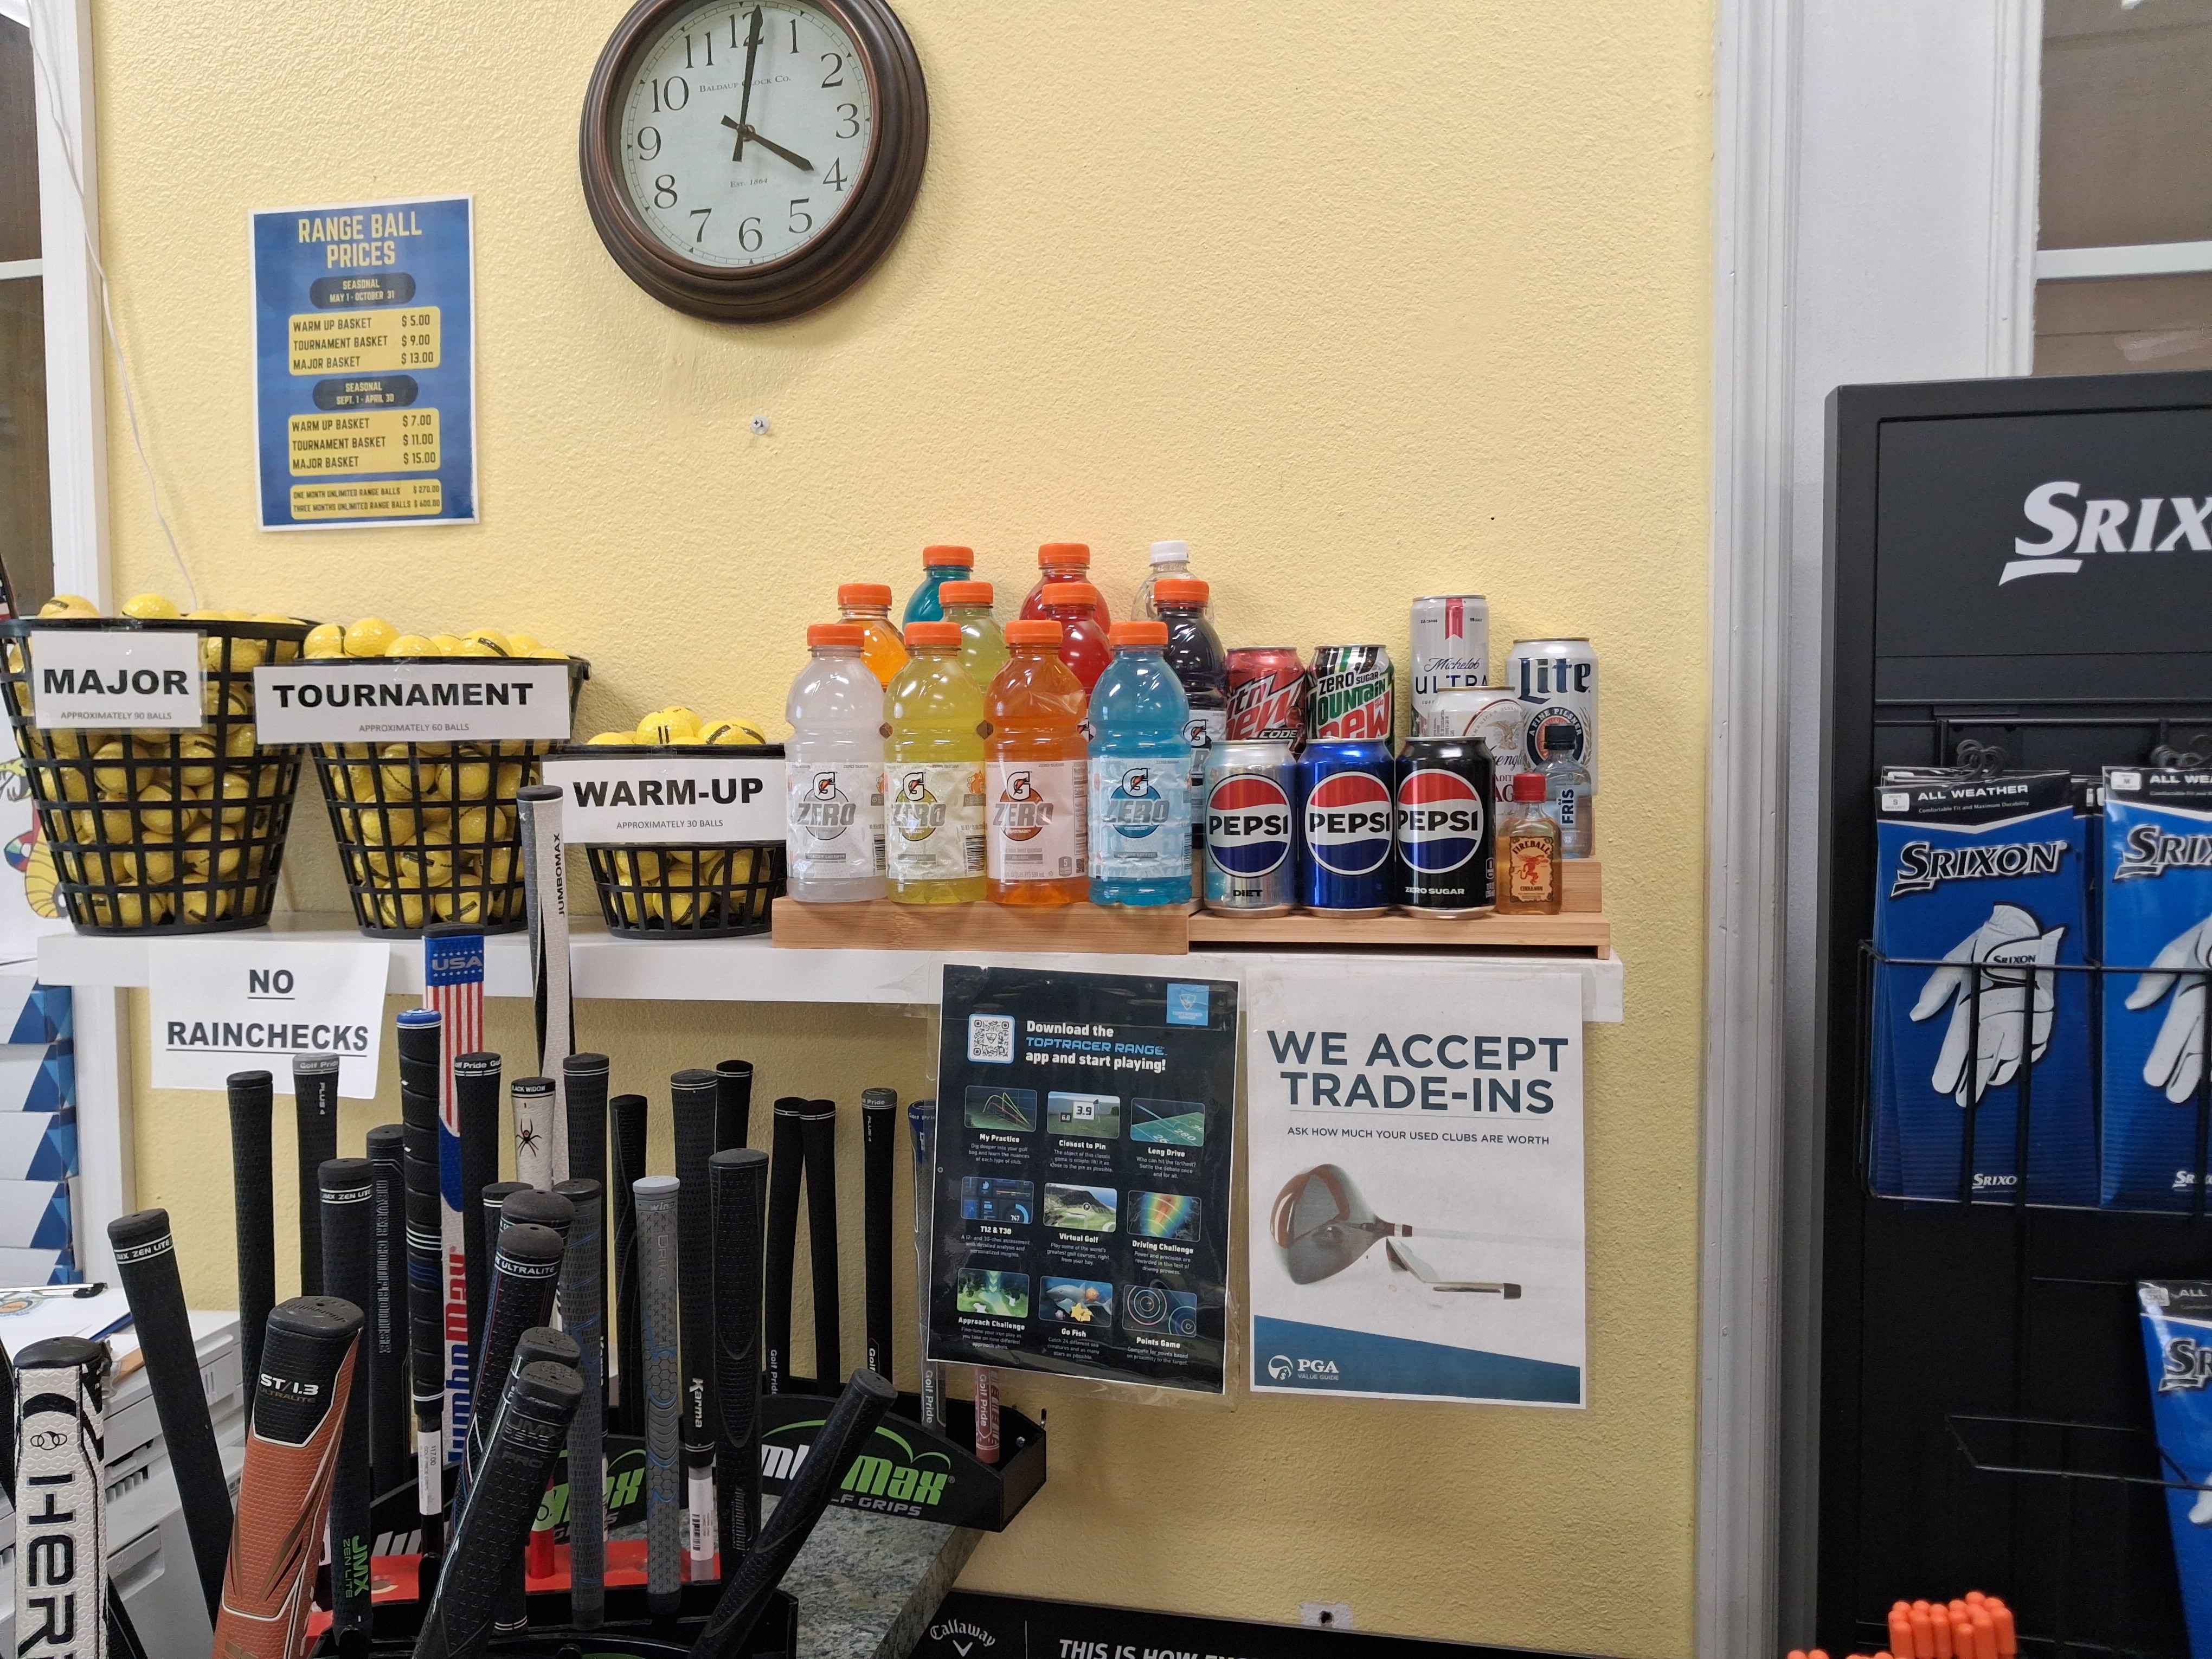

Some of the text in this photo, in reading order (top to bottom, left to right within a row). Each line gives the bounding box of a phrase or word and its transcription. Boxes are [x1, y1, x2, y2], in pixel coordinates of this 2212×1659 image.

[728, 11, 765, 49] 12
[788, 18, 800, 54] 1
[684, 31, 715, 69] 11
[820, 53, 844, 88] 2
[651, 75, 690, 113] 10
[835, 103, 860, 139] 3
[636, 126, 662, 161] 9
[822, 157, 848, 191] 4
[653, 174, 678, 209] 8
[689, 208, 712, 242] 7
[788, 198, 813, 234] 5
[298, 211, 422, 243] RANGE BALL
[738, 217, 763, 252] 6
[327, 241, 396, 269] PRICES
[343, 279, 380, 290] SEASONAL
[330, 293, 344, 303] MAY
[355, 291, 383, 301] OCTOBER
[387, 291, 394, 299] 31
[293, 320, 321, 332] WARM
[324, 319, 335, 330] UP
[338, 318, 372, 329] BASKET
[294, 338, 351, 351] TOURNAMENT
[355, 335, 388, 349] BASKET
[293, 358, 324, 370] MAJOR
[326, 356, 361, 368] BASKET
[345, 382, 382, 393] SEASONAL
[336, 395, 355, 405] SEPT.
[365, 394, 384, 404] APRIL
[386, 394, 395, 402] 30
[292, 420, 320, 433] WARM
[322, 419, 333, 430] UP
[336, 417, 370, 429] BASKET
[292, 438, 349, 451] TOURNAMENT
[352, 436, 386, 448] BASKET
[293, 457, 323, 470] MAJOR
[325, 455, 359, 468] BASKET
[293, 491, 304, 499] ONE
[306, 490, 326, 498] MONTH
[327, 488, 358, 498] UNLIMITED
[359, 488, 379, 497] RANGE
[381, 487, 401, 496] BALLS
[293, 504, 311, 512] THREE
[312, 503, 336, 512] MONTHS
[338, 502, 369, 511] UNLIMITED
[370, 501, 390, 510] RANGE
[391, 500, 411, 509] BALLS
[1424, 658, 1482, 672] Michelob
[44, 668, 190, 696] MAJOR
[1518, 658, 1591, 705] Lite
[272, 682, 534, 708] TOURNAMENT
[60, 711, 172, 721] APPROXIMATELY 90 BALLS
[359, 723, 470, 733] APPROXIMATELY 60 BALLS
[2150, 775, 2181, 783] ALL
[573, 777, 763, 808] WARM-UP
[1918, 785, 2028, 801] ALL WEATHER
[798, 803, 857, 826] ZERO
[993, 802, 1054, 827] ZERO
[1102, 800, 1170, 825] ZERO
[1397, 810, 1478, 831] PEPSI
[616, 820, 723, 830] APPROXIMATELY 30 BALLS
[1209, 814, 1288, 836] PEPSI
[1309, 812, 1390, 833] PEPSI
[1512, 840, 1552, 856] FIREBALL
[1897, 840, 2060, 883] SRIXON
[552, 832, 565, 916] JUMBOMAX
[1405, 886, 1465, 895] ZERO SUGAR
[431, 957, 483, 972] USA
[1992, 954, 2036, 964] SRIXON
[249, 969, 295, 994] NO
[166, 1021, 369, 1051] RAINCHECKS
[1027, 1020, 1114, 1037] Download the
[1026, 1037, 1111, 1052] TOPTRACER
[1266, 1030, 1568, 1072] WE ACCEPT
[463, 1060, 487, 1069] Pride
[1026, 1052, 1166, 1073] app and start playing!
[1280, 1071, 1554, 1115] TRADE-INS
[980, 1134, 1020, 1143] My Practice
[1059, 1140, 1084, 1148] Closest
[1287, 1127, 1549, 1145] ASK HOW MUCH YOUR USED CLUBS ARE WORTH
[1148, 1147, 1185, 1158] Long Drive
[1059, 1233, 1083, 1242] Virtual
[1132, 1240, 1194, 1255] Driving Challenge
[501, 1261, 555, 1276] ULTRALITE
[959, 1317, 1025, 1331] Approach Challenge
[1072, 1329, 1086, 1337] Fish
[1136, 1336, 1180, 1348] Points Game
[1297, 1359, 1340, 1374] PGA
[690, 1378, 704, 1428] Karma
[925, 1394, 934, 1424] Pride
[979, 1397, 987, 1427] Pride
[858, 1499, 922, 1516] GRIPS
[352, 1535, 369, 1597] JMX
[930, 1619, 996, 1647] Callaway
[1059, 1639, 1136, 1659] THIS IS
